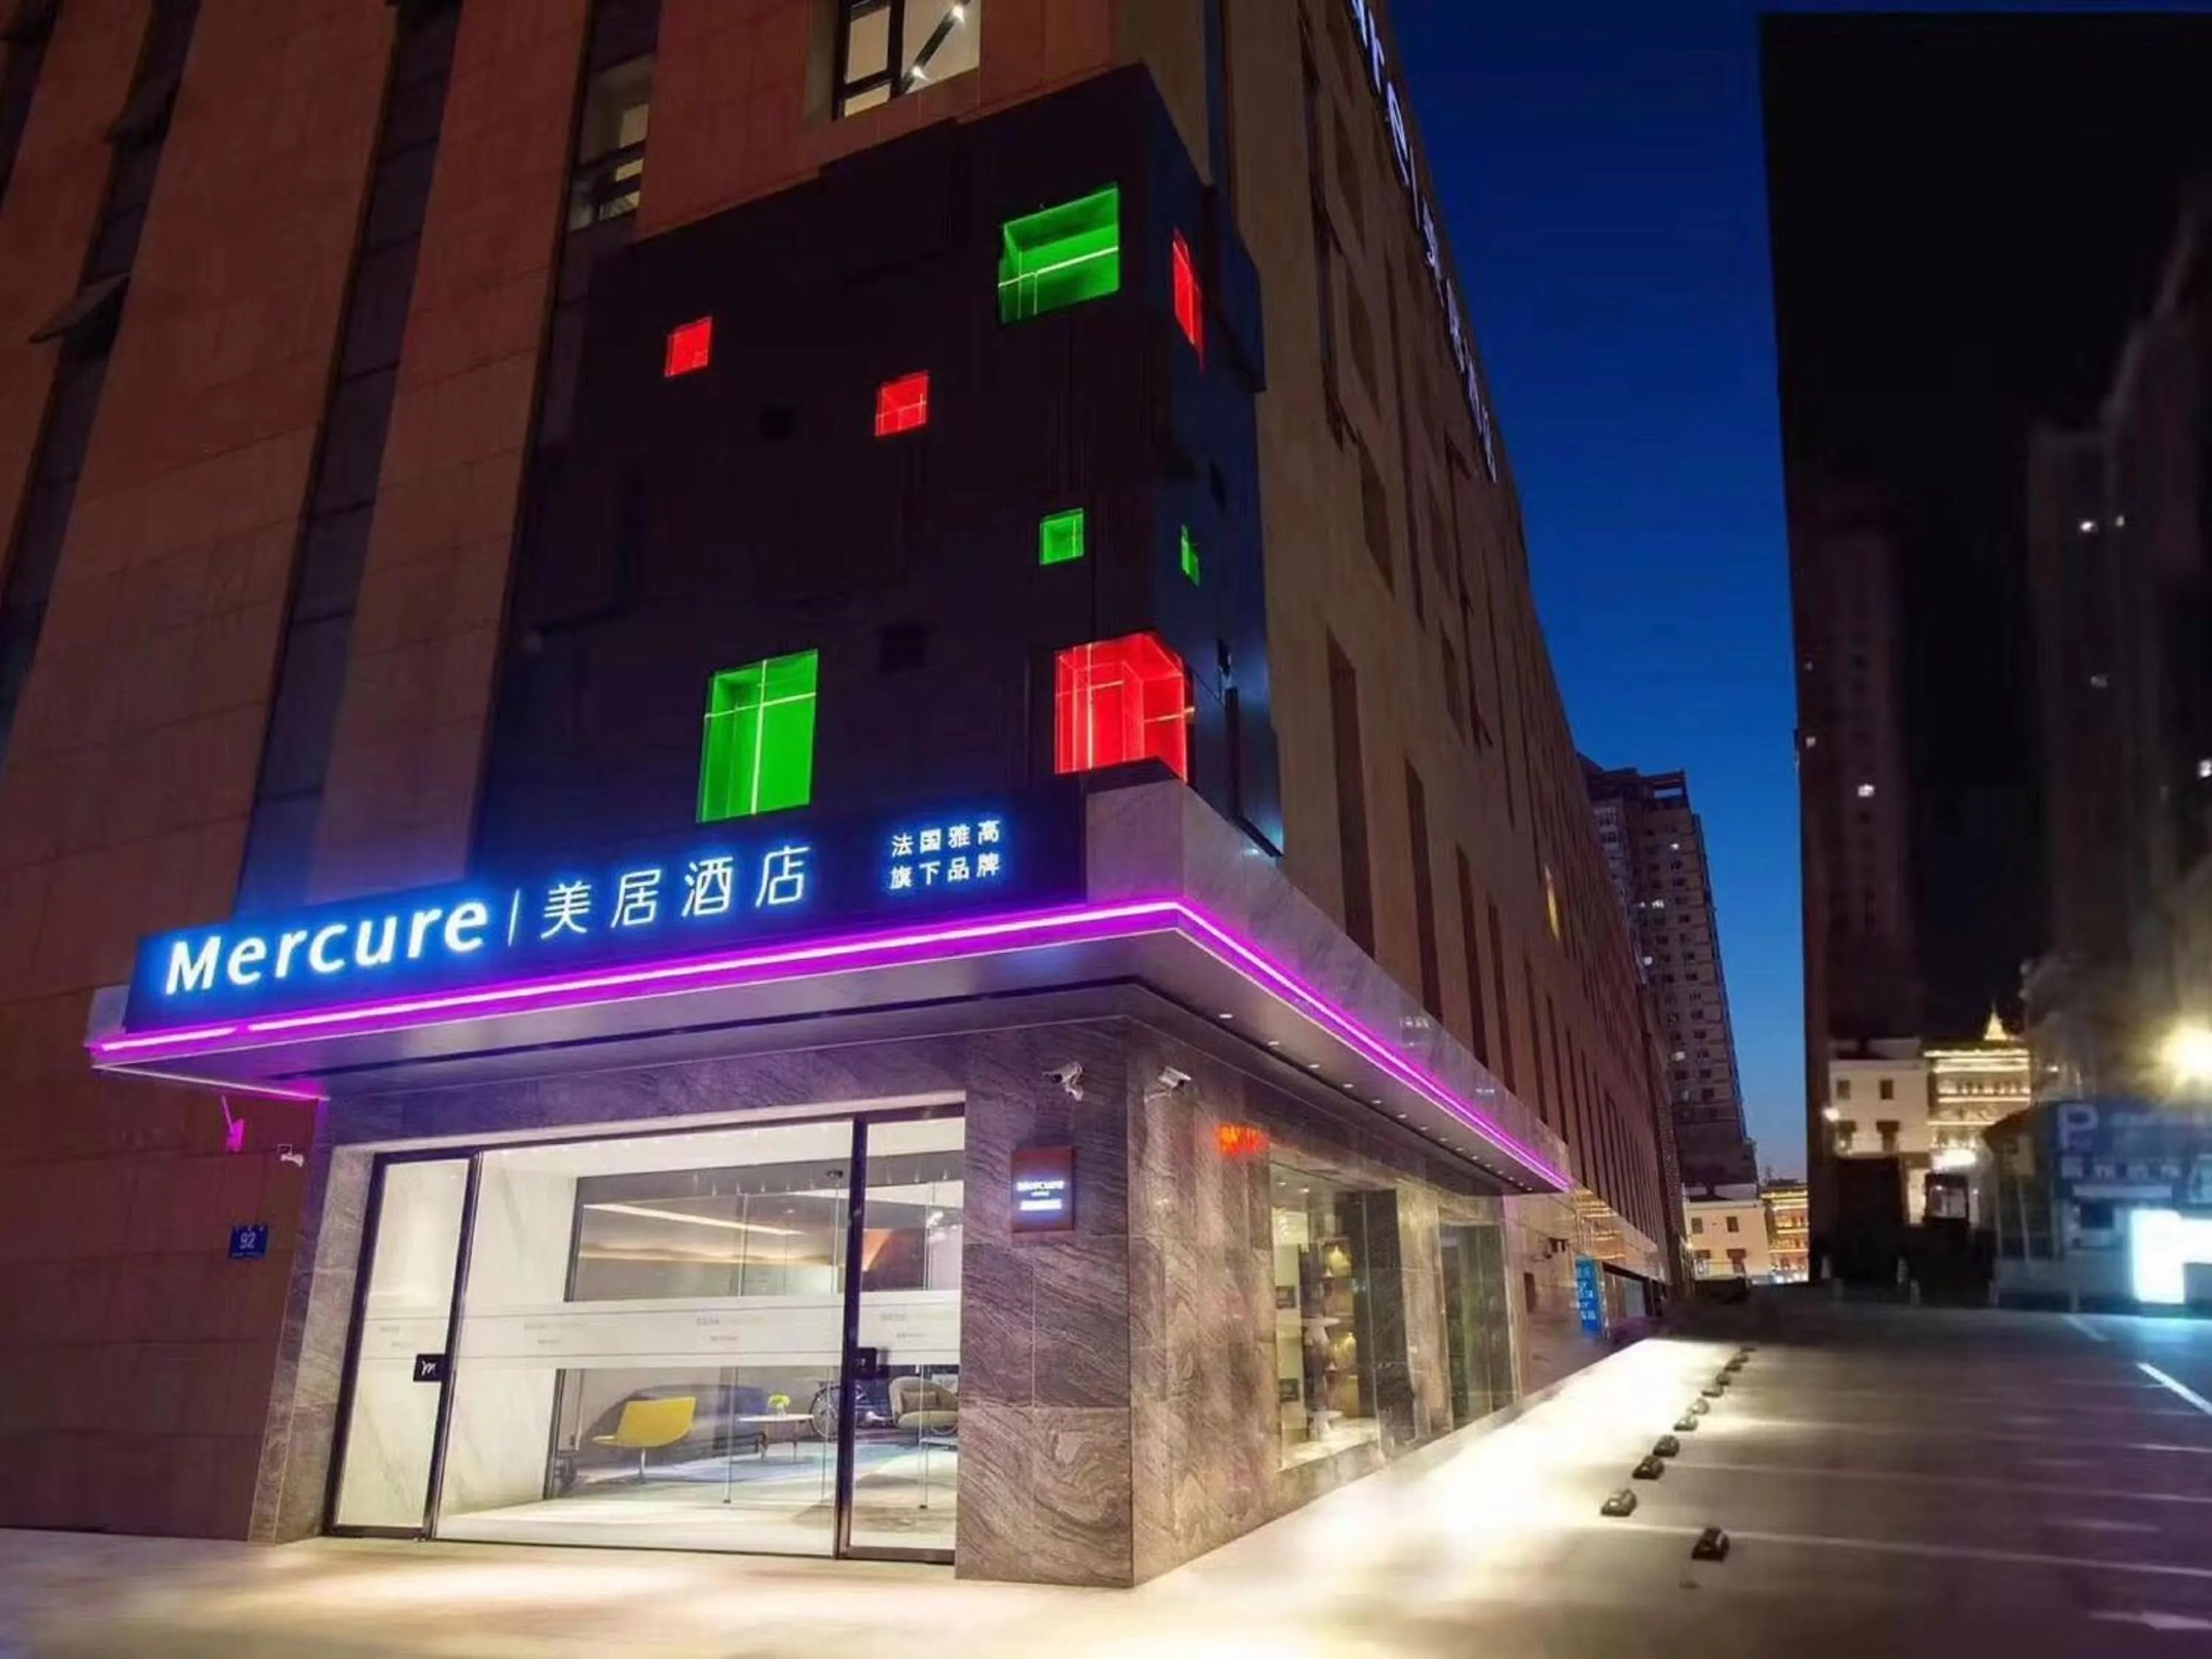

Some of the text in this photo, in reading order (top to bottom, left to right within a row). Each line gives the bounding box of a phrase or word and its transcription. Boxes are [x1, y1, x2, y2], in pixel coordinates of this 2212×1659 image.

[891, 819, 1001, 858] 法国雅高
[889, 852, 1001, 890] 旗下品牌
[165, 845, 810, 995] Mercure 美居酒店
